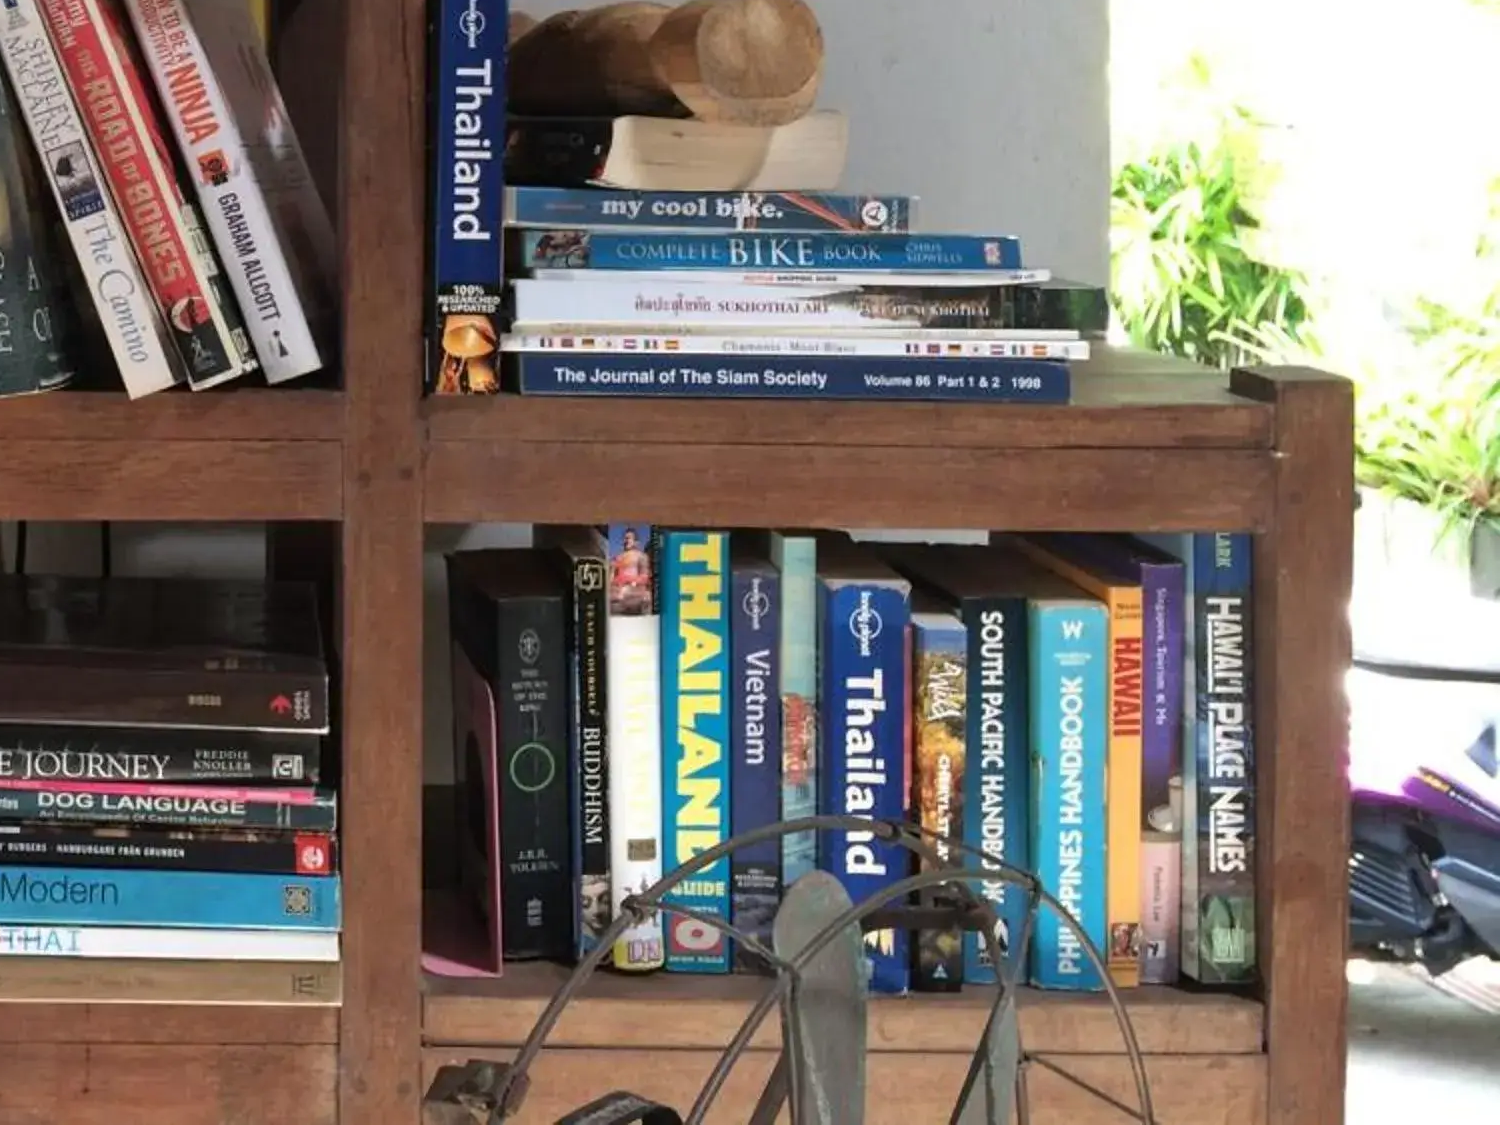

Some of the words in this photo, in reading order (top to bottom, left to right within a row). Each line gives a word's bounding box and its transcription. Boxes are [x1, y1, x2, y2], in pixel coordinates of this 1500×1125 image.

[25, 38, 77, 140] SHIRLEY
[84, 75, 138, 163] ROAD
[164, 62, 221, 146] NINJA
[453, 58, 493, 241] Thailand
[85, 214, 118, 265] The
[600, 197, 644, 221] my
[651, 198, 708, 217] cool
[217, 192, 258, 259] GRAHAM
[242, 257, 281, 322] ALLCOTT
[453, 284, 485, 296] 100%
[616, 242, 723, 260] COMPLETE
[728, 238, 816, 267] BIKE
[822, 244, 883, 261] BOOK
[99, 269, 148, 363] Camino
[718, 301, 801, 314] SUKHOTHAI
[803, 300, 829, 314] ART
[554, 366, 587, 382] The
[590, 366, 656, 383] Journal
[658, 366, 677, 383] of
[680, 367, 713, 383] The
[716, 367, 760, 385] Siam
[763, 368, 828, 389] Society
[863, 374, 913, 388] Volume
[915, 375, 931, 388] 86
[937, 375, 965, 388] Part
[968, 375, 975, 388] 1
[979, 375, 990, 388] &
[991, 376, 1001, 389] 2
[1011, 376, 1042, 390] 1998
[980, 611, 1005, 687] SOUTH
[1113, 637, 1143, 737] HAWAII
[676, 533, 722, 874] THAILAND
[745, 649, 771, 766] Vietnam
[980, 692, 1006, 769] PACIFIC
[1209, 702, 1246, 780] PLACE
[23, 748, 171, 780] JOURNEY
[192, 760, 252, 772] KNOLLER
[195, 748, 250, 760] FREDDIE
[583, 727, 603, 845] BUDDHISM
[845, 668, 888, 876] Thailand
[1059, 676, 1084, 824] HANDBOOK
[37, 791, 94, 809] DOG
[100, 794, 248, 816] LANGUAGE
[1210, 785, 1247, 874] NAMES
[1, 873, 120, 906] Modern
